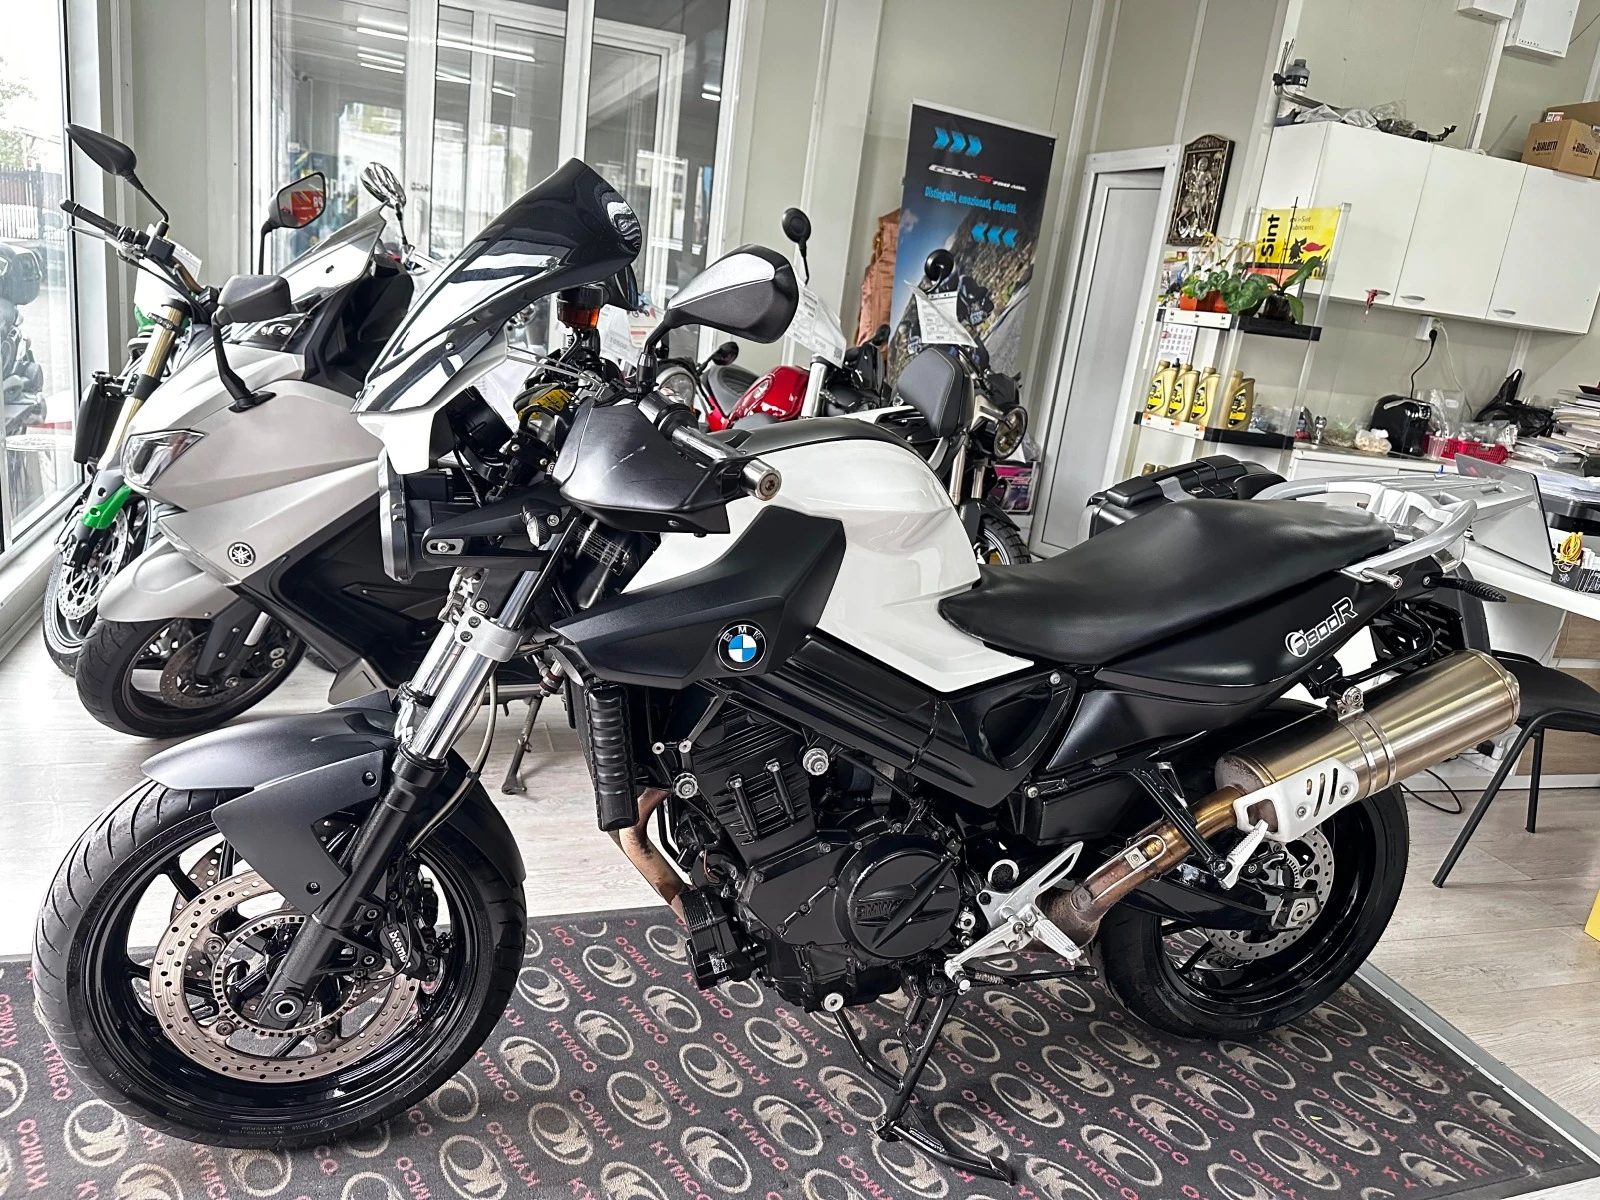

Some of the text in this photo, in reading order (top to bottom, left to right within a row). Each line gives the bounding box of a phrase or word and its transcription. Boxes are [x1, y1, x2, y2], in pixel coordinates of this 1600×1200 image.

[928, 164, 993, 183] GSX-S
[722, 625, 763, 642] BMW
[855, 900, 893, 919] BMW
[551, 957, 596, 1001] KYMCO
[615, 936, 662, 978] KYMCO
[546, 1019, 597, 1073] KYMCO
[618, 995, 669, 1045] KYMCO
[774, 1007, 833, 1057] KYMCO
[963, 999, 1027, 1047] KYMCO
[713, 1032, 770, 1086] KYMCO
[1064, 1035, 1136, 1085] KYMCO
[1200, 1051, 1278, 1101] KYMCO
[1350, 1060, 1432, 1111] KYMCO
[1383, 1035, 1465, 1083] KYMCO
[643, 1059, 702, 1118] KYMCO
[792, 1077, 858, 1136] KYMCO
[1015, 1060, 1087, 1115] KYMCO
[1156, 1078, 1236, 1132] KYMCO
[569, 1089, 624, 1150] KYMCO
[725, 1107, 789, 1171] KYMCO
[961, 1089, 1034, 1147] KYMCO
[1109, 1106, 1189, 1166] KYMCO
[1312, 1088, 1398, 1143] KYMCO
[1453, 1103, 1545, 1159] KYMCO
[17, 1119, 48, 1191] KYMCO
[487, 1121, 540, 1187] KYMCO
[1057, 1138, 1139, 1200] KYMCO
[1272, 1117, 1360, 1177] KYMCO
